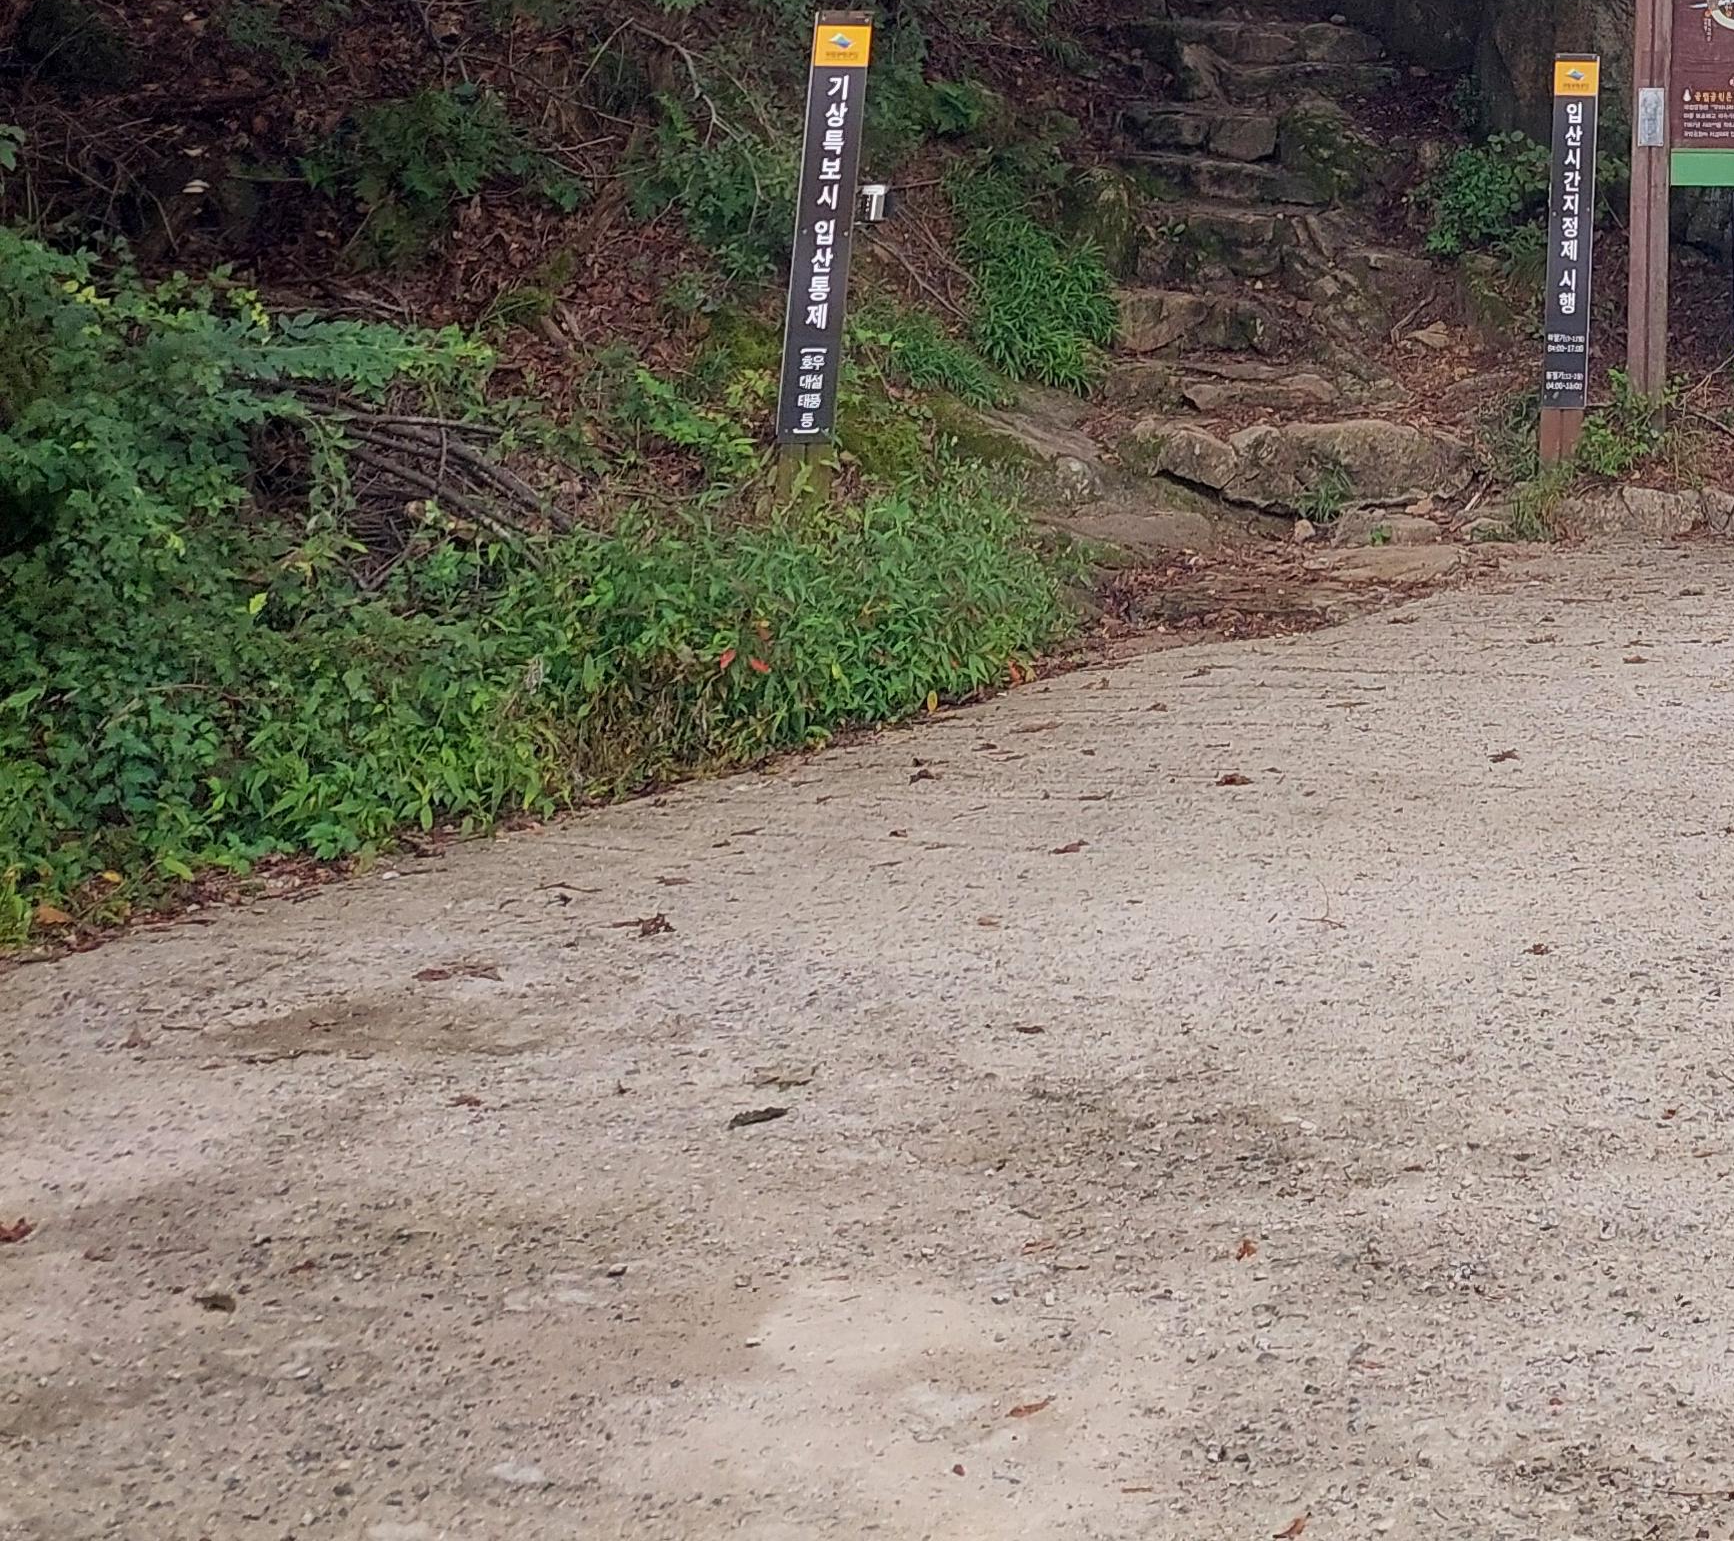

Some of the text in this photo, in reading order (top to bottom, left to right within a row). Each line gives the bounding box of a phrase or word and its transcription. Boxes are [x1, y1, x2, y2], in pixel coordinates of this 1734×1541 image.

[816, 75, 850, 210] 기상특보시
[1560, 102, 1583, 261] 입산시간지정제
[805, 219, 836, 330] 입산통제
[1559, 269, 1577, 314] 시행
[797, 393, 821, 408] 태풍
[799, 374, 823, 389] 대설
